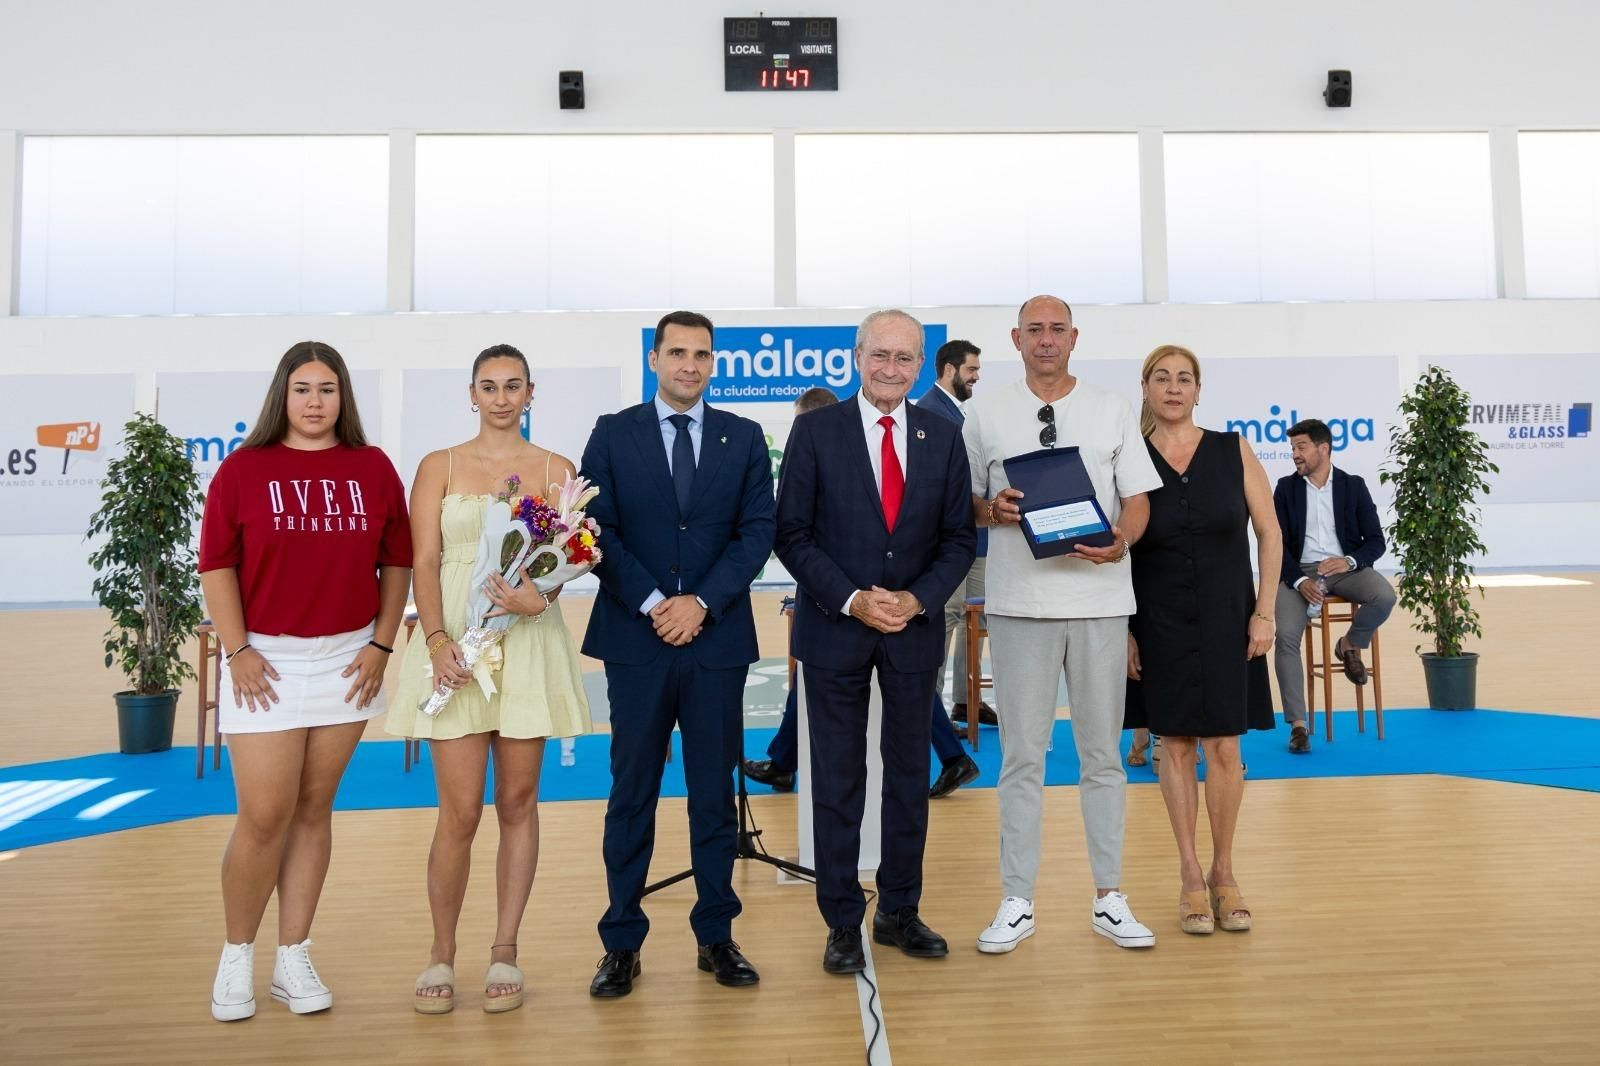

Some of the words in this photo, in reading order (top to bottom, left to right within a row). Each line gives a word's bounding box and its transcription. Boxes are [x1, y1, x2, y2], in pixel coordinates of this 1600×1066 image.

[729, 45, 762, 54] LOCAL
[800, 45, 832, 54] VISITANTE
[710, 385, 721, 396] la
[724, 385, 768, 396] ciudad
[1468, 404, 1564, 424] RVIMETAL
[1515, 441, 1527, 450] DE
[1528, 440, 1538, 449] LA
[1540, 440, 1565, 449] TORRE
[57, 478, 101, 486] DEPORT
[268, 479, 366, 515] OVER
[273, 516, 368, 531] THINKING
